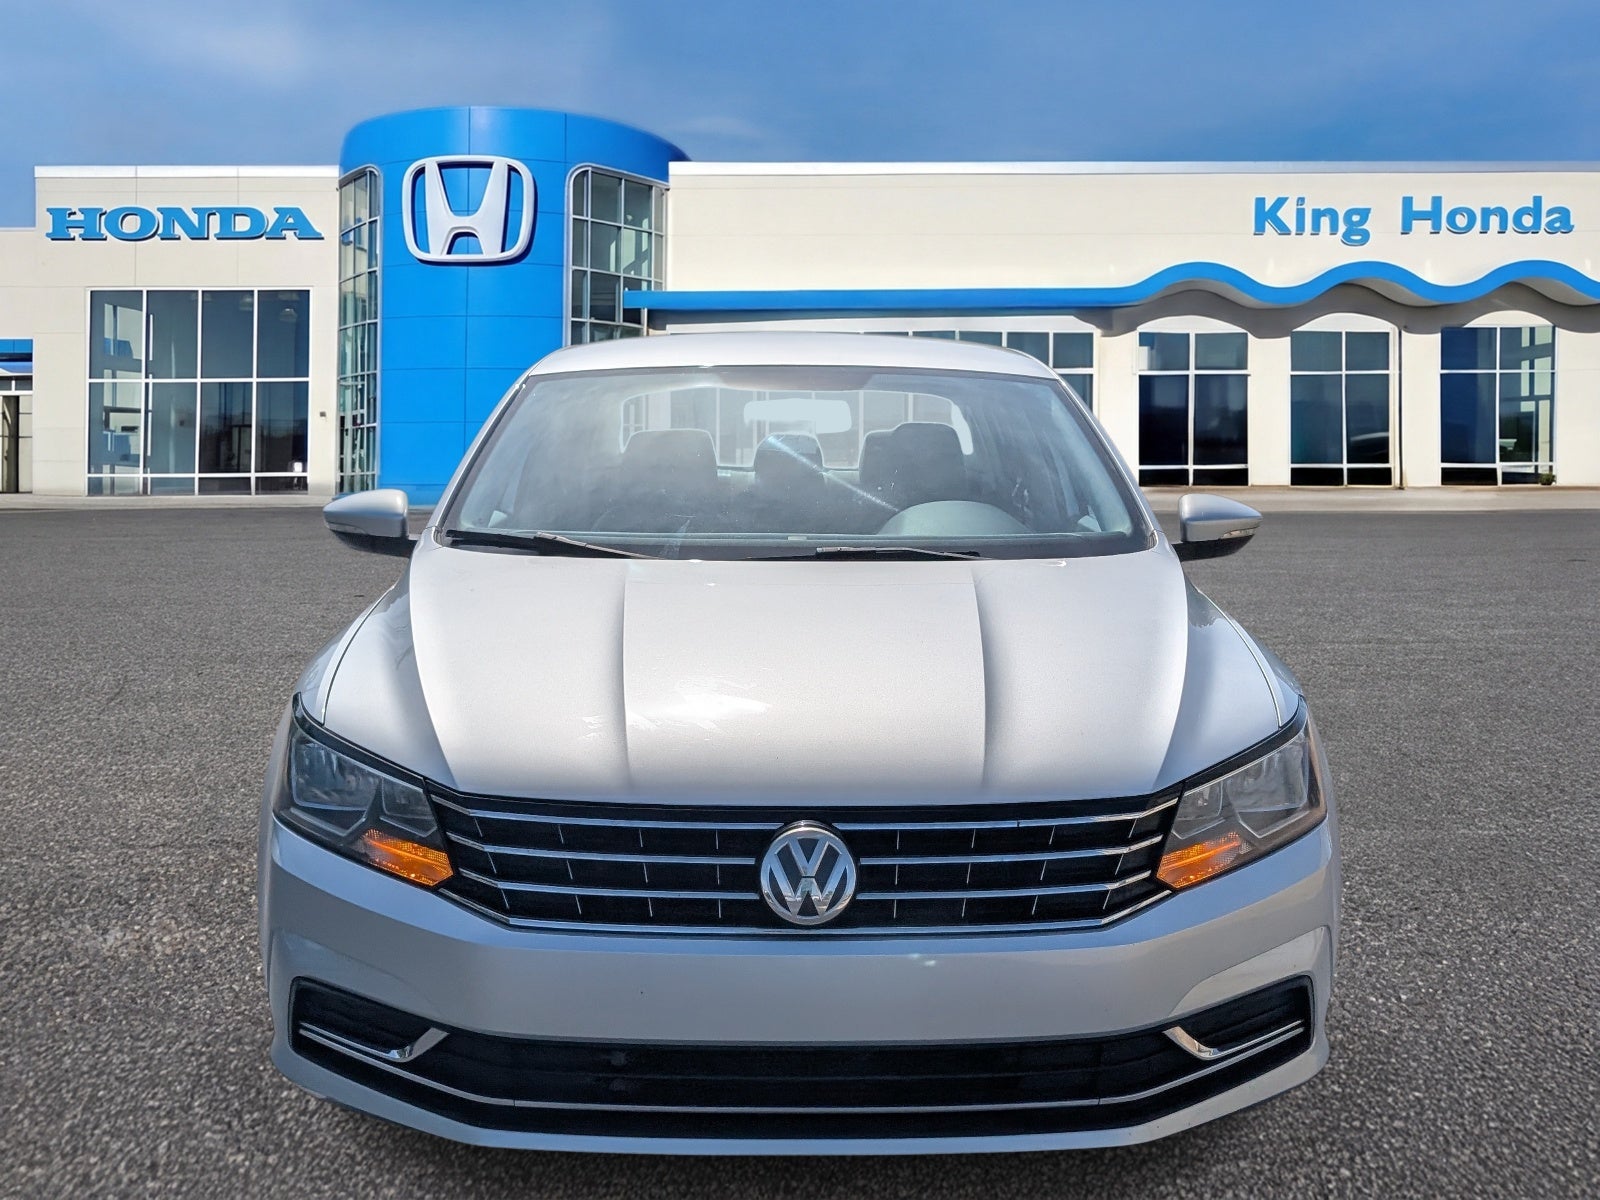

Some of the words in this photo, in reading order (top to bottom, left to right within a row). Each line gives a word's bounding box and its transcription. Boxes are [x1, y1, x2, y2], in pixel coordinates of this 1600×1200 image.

[46, 206, 324, 241] HONDA
[1253, 196, 1372, 246] King
[1400, 195, 1575, 235] Honda
